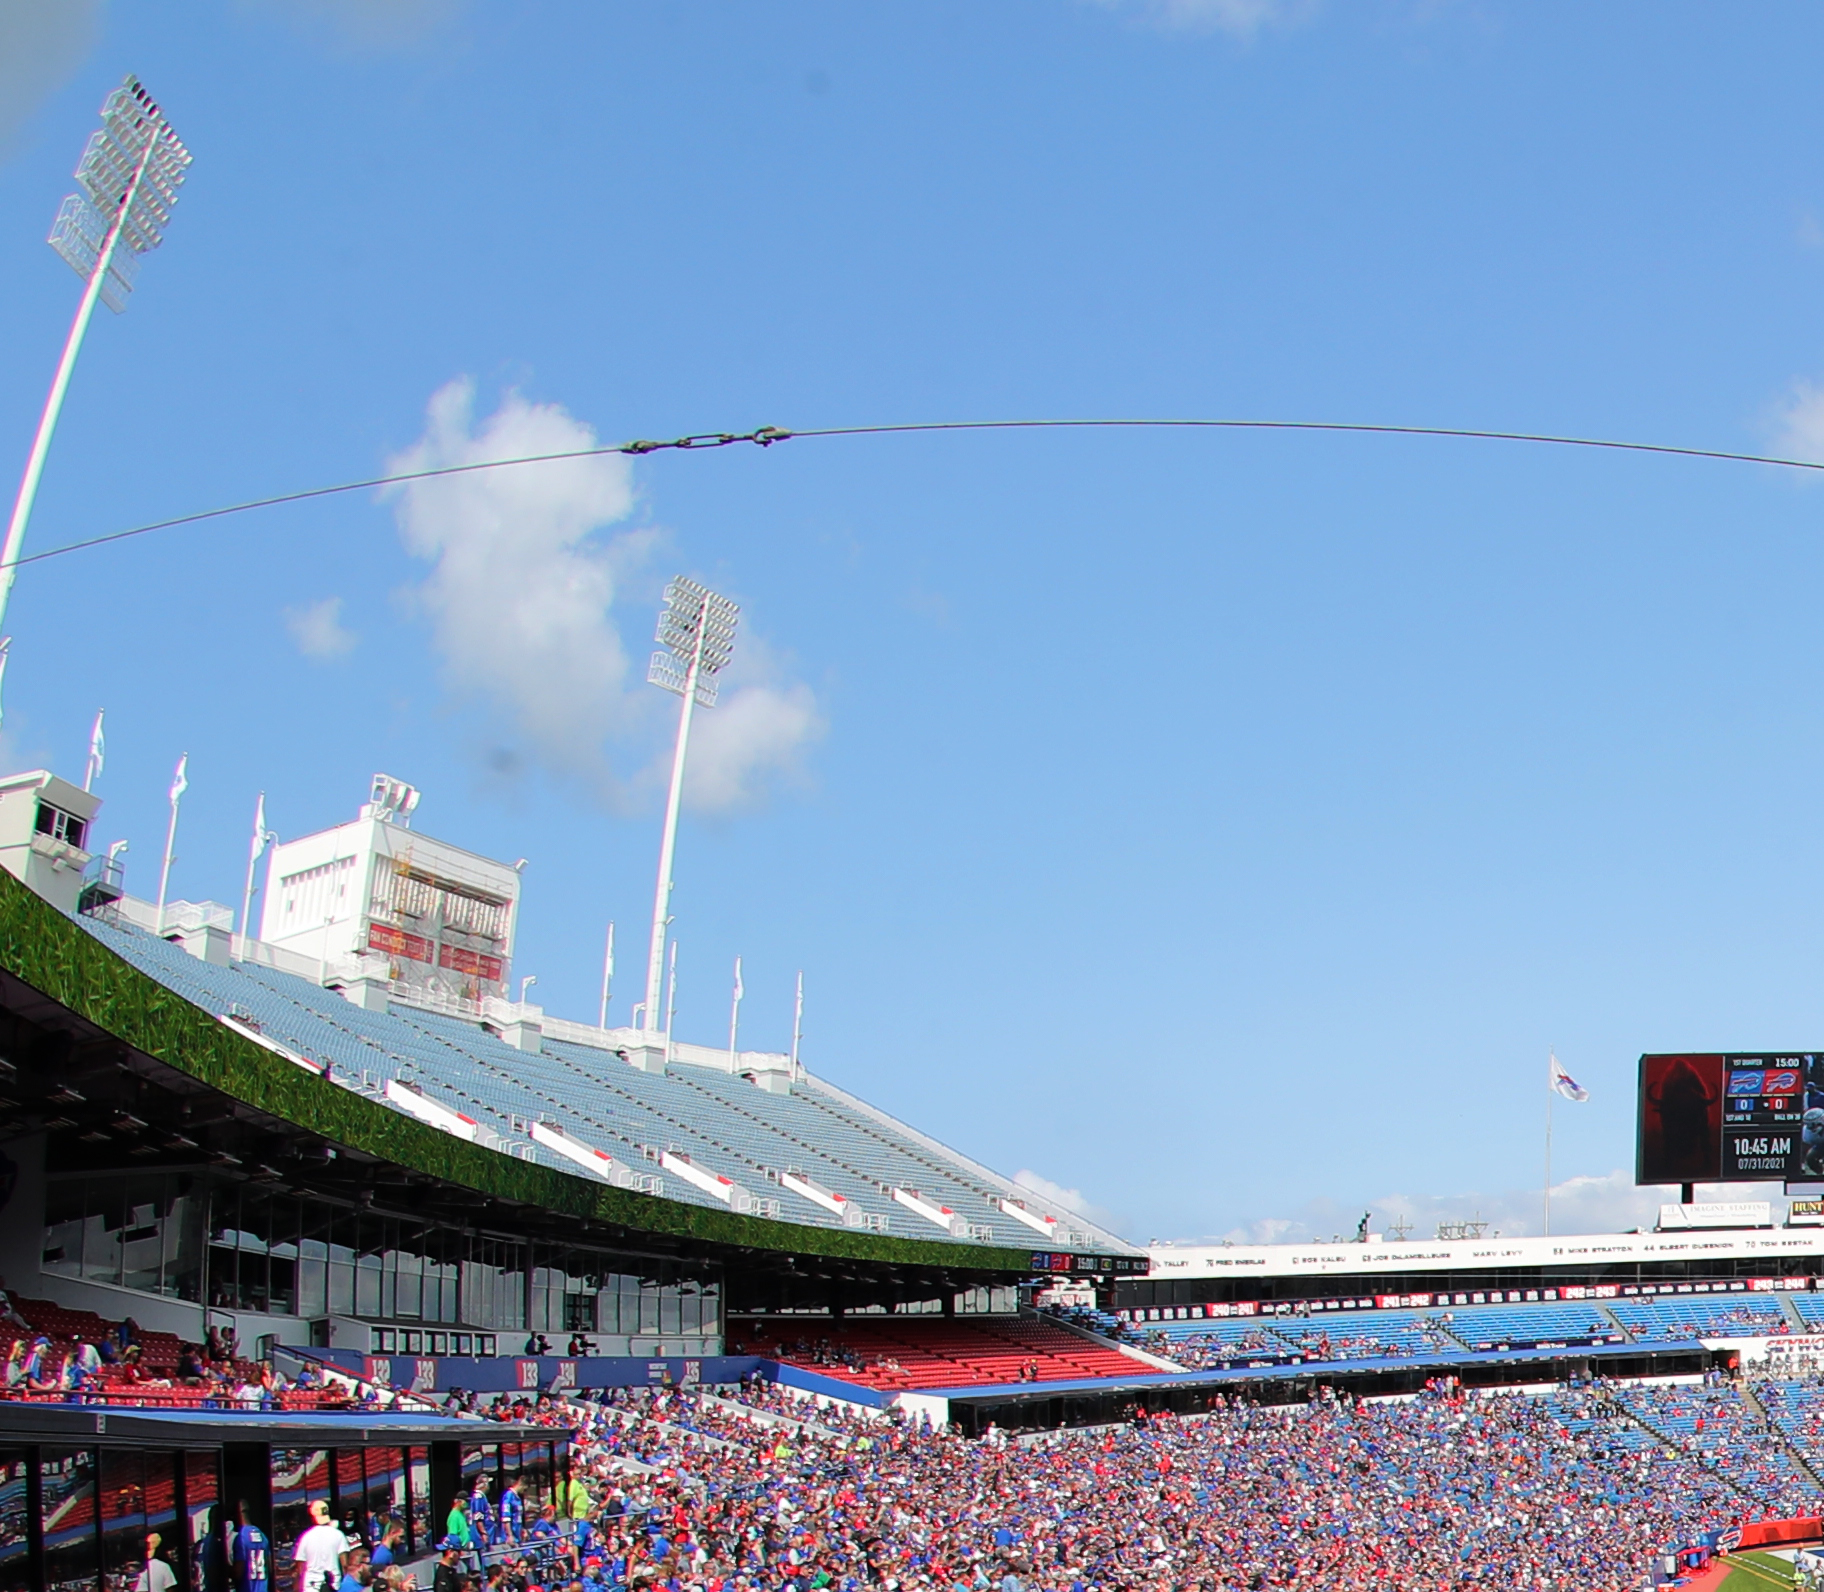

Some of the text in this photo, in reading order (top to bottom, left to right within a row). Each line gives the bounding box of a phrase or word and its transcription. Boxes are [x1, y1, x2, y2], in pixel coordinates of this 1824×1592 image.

[1775, 1057, 1800, 1068] 15:00
[1740, 1099, 1748, 1110] 0
[1774, 1098, 1783, 1110] 0
[1733, 1137, 1791, 1155] 10:45 AM
[1737, 1156, 1785, 1170] 07/31/2021
[1793, 1202, 1824, 1213] HUNT
[1753, 1278, 1774, 1290] 243
[1784, 1278, 1805, 1290] 244
[1565, 1287, 1586, 1299] 242
[1595, 1286, 1617, 1298] 243
[1382, 1295, 1400, 1307] 241
[1409, 1294, 1430, 1306] 242
[1211, 1303, 1230, 1316] 240
[1237, 1302, 1255, 1315] 241
[416, 1360, 436, 1390] 133
[521, 1361, 539, 1389] 133
[249, 1549, 266, 1580] 14
